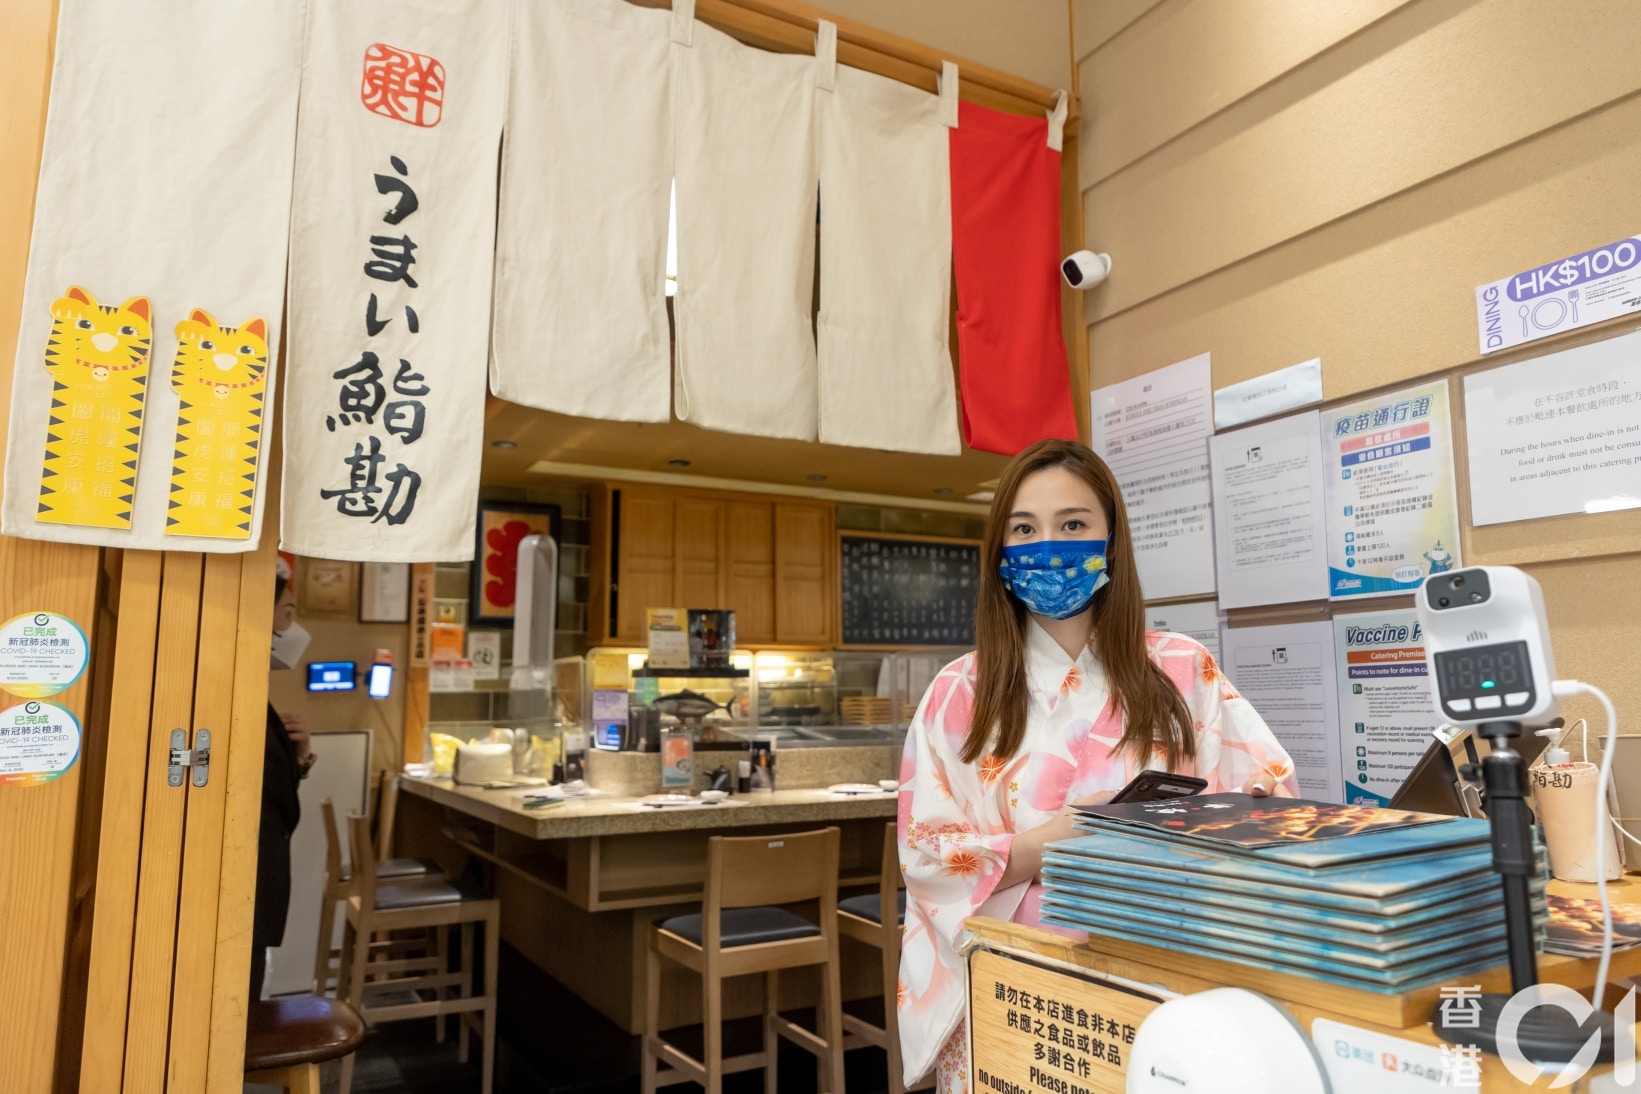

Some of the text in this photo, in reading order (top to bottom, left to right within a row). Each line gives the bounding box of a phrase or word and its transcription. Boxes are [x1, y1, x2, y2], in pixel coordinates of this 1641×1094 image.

[361, 43, 446, 128] 鮮
[1515, 242, 1636, 299] HK$100
[1483, 285, 1503, 349] DINING
[320, 155, 431, 526] うまい鮨勘
[1335, 396, 1432, 436] 疫苗通行證
[1500, 424, 1640, 456] During the hours when dine-in is not
[1518, 458, 1535, 467] food
[1546, 452, 1567, 461] drink
[1569, 449, 1588, 458] must
[1590, 446, 1603, 455] not
[1605, 444, 1615, 452] be
[1510, 475, 1518, 483] in
[1518, 472, 1538, 481] areas
[1539, 468, 1571, 479] adjacent
[1572, 465, 1581, 473] to
[1582, 462, 1597, 471] this
[1599, 457, 1632, 468] catering
[8, 637, 70, 647] 新冠肺炎檢測
[23, 626, 58, 637] 已完成
[1346, 625, 1408, 645] Vaccine
[1370, 651, 1398, 660] Catering
[0, 725, 63, 737] 新冠肺炎檢測
[14, 714, 49, 726] 已完成
[32, 734, 69, 743] CHECKED
[994, 981, 1136, 1045] 請勿在本店進食非本店
[1007, 1009, 1121, 1067] 供應之食品或飲品
[1034, 1042, 1091, 1079] 多謝合作
[978, 1068, 989, 1085] no
[1029, 1066, 1068, 1094] Please
